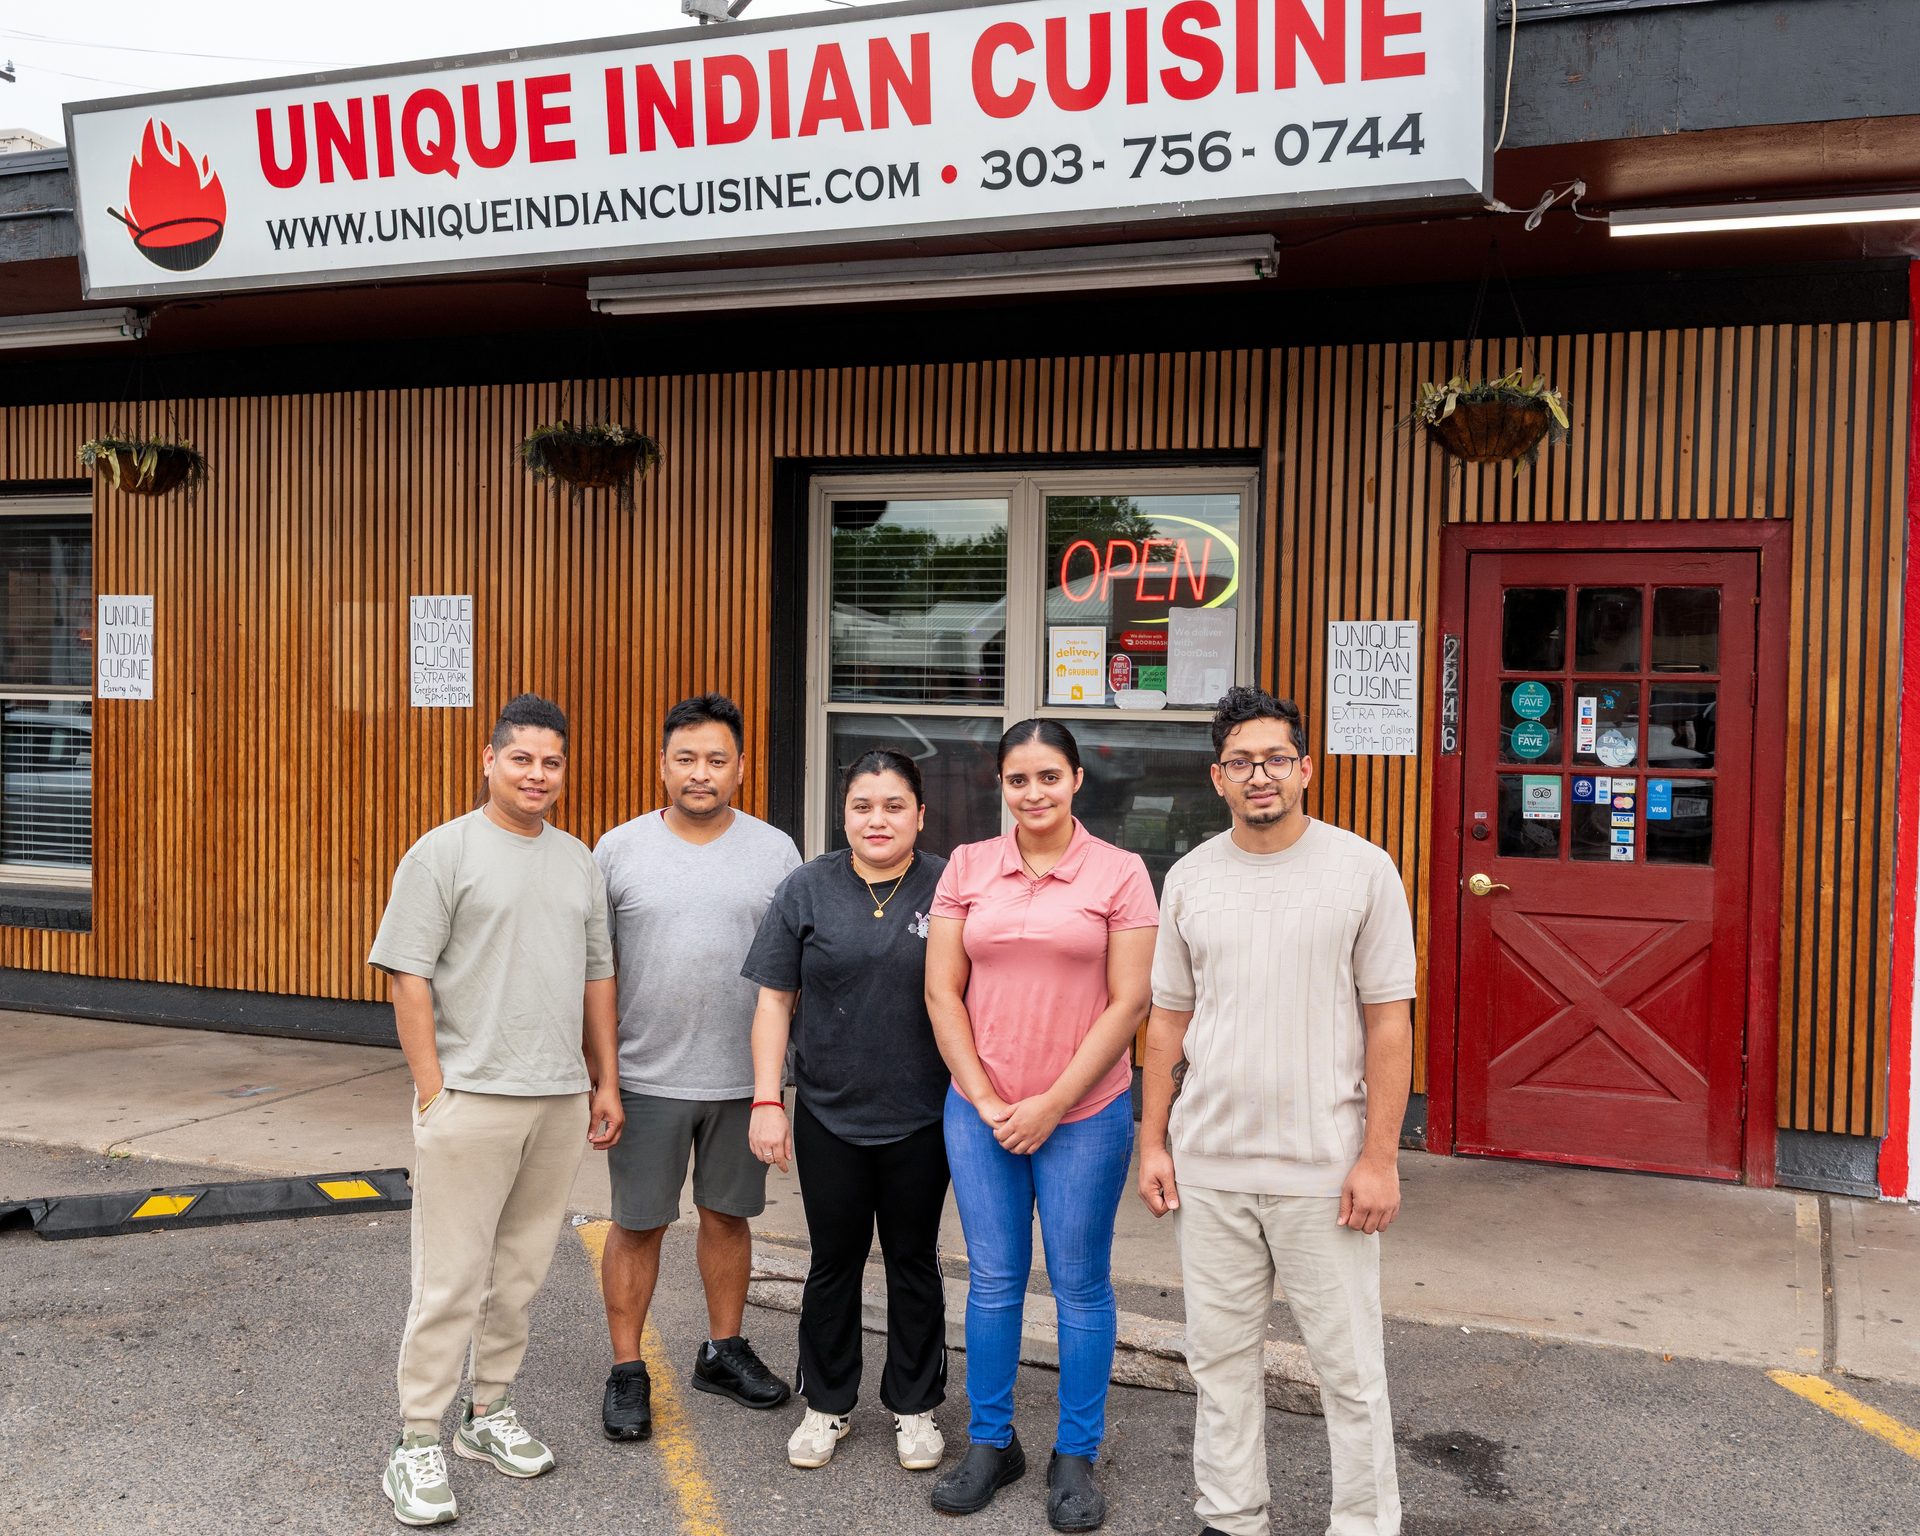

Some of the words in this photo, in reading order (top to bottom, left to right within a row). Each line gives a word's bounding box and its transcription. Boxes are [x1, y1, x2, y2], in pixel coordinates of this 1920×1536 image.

[256, 74, 577, 188] UNIQUE
[604, 33, 932, 155] INDIAN
[971, 0, 1426, 119] CUISINE
[266, 162, 921, 251] WWW.UNIQUEINDIANCUISINE.COM
[1274, 112, 1426, 167] 0744
[1061, 538, 1212, 602] OPEN
[104, 605, 152, 627] UNIQUE
[414, 598, 471, 622] UNIQUE
[413, 621, 471, 645] INDIAN
[1174, 627, 1190, 637] We
[1192, 627, 1223, 637] deliver
[1174, 639, 1193, 647] with
[1334, 623, 1412, 650] UNIQUE
[105, 632, 153, 656] INDIAN
[1056, 646, 1099, 660] delivery
[1174, 648, 1218, 658] DoorDash
[414, 645, 470, 669] CUISINE
[1335, 648, 1410, 674] INDIAN
[100, 658, 150, 680] CUISINE
[413, 671, 446, 684] EXTRA
[1068, 668, 1099, 677] GRUBHUB
[129, 684, 142, 696] Only
[1333, 673, 1413, 700] CUISINE
[1442, 638, 1459, 751] 2246
[1331, 705, 1376, 720] EXTRA
[1519, 698, 1543, 707] FAVE
[1333, 721, 1373, 734] Gerber
[1379, 723, 1415, 735] Collision
[1518, 737, 1543, 747] FAVE
